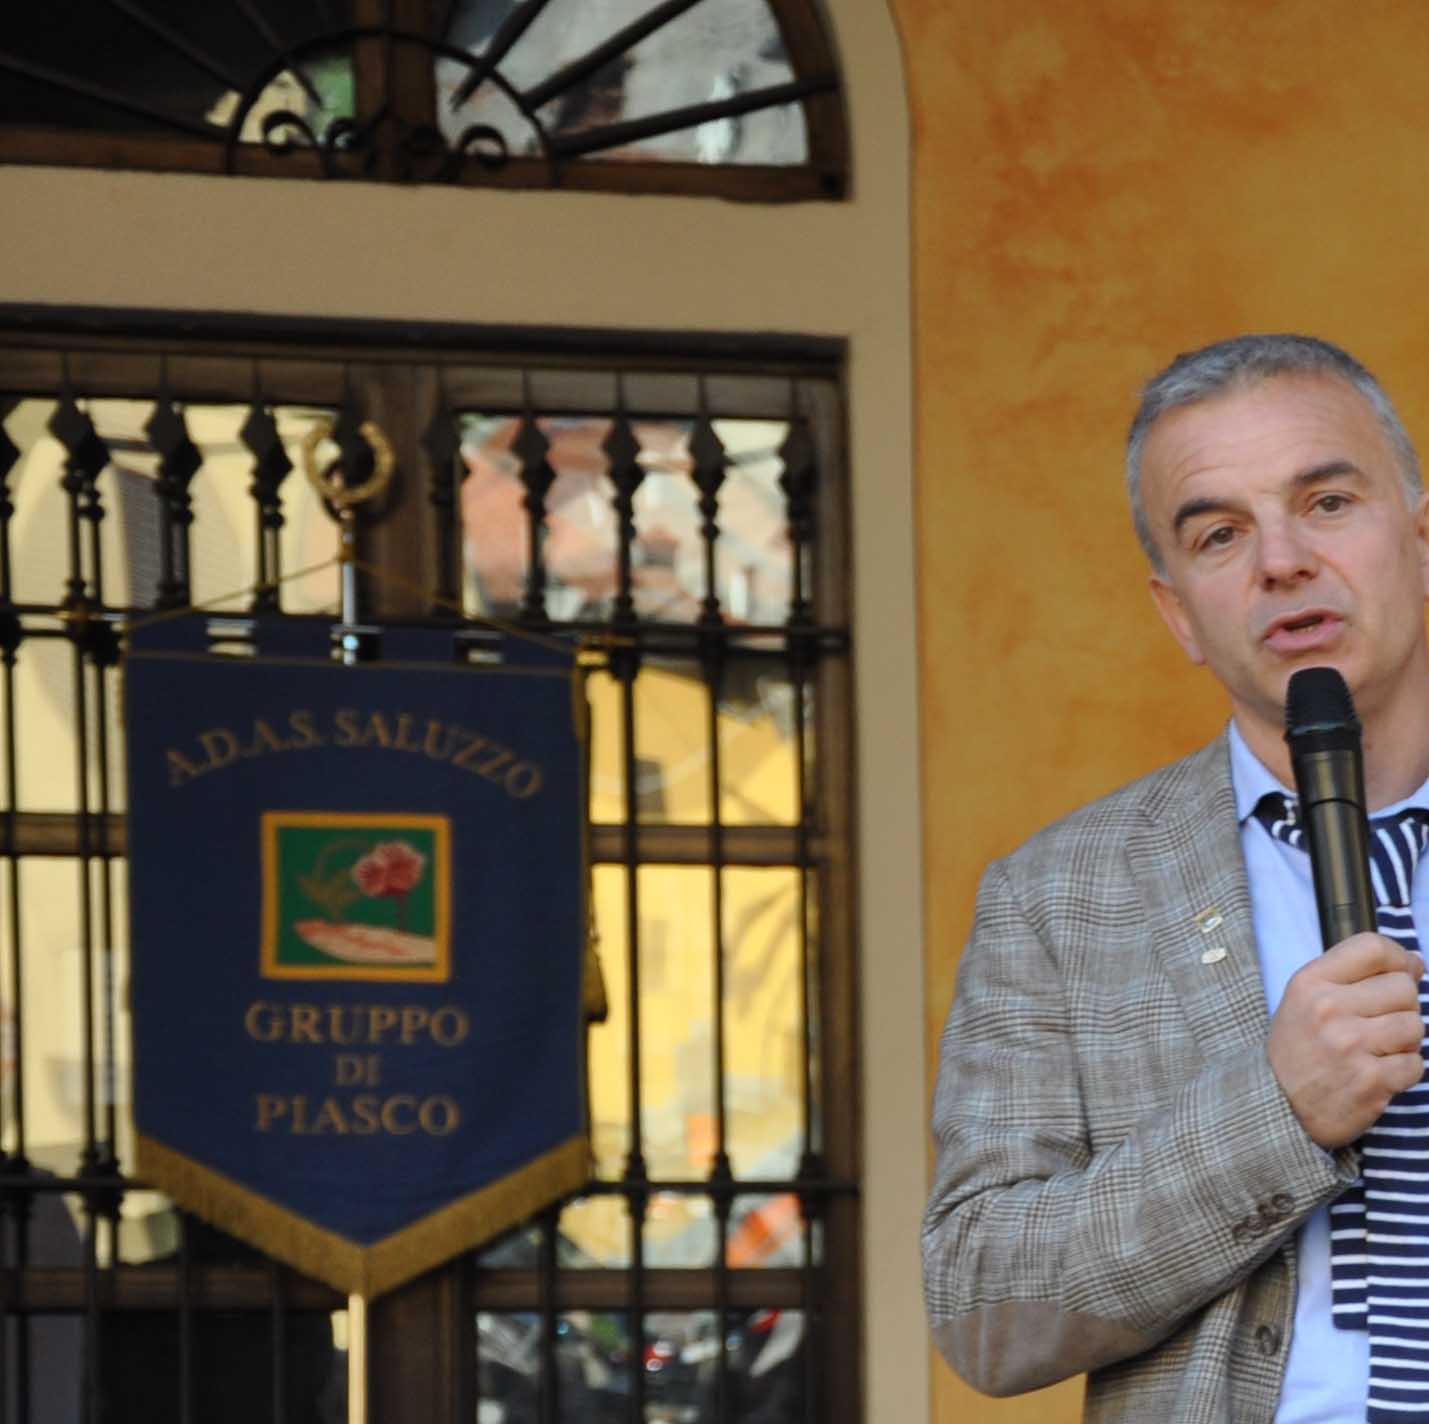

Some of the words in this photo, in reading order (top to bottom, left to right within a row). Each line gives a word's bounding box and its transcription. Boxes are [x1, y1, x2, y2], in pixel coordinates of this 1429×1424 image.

[333, 710, 544, 799] SALUZZO
[245, 1002, 469, 1046] GRUPPO
[336, 1054, 381, 1084] DI
[256, 1096, 461, 1135] PIASCO
